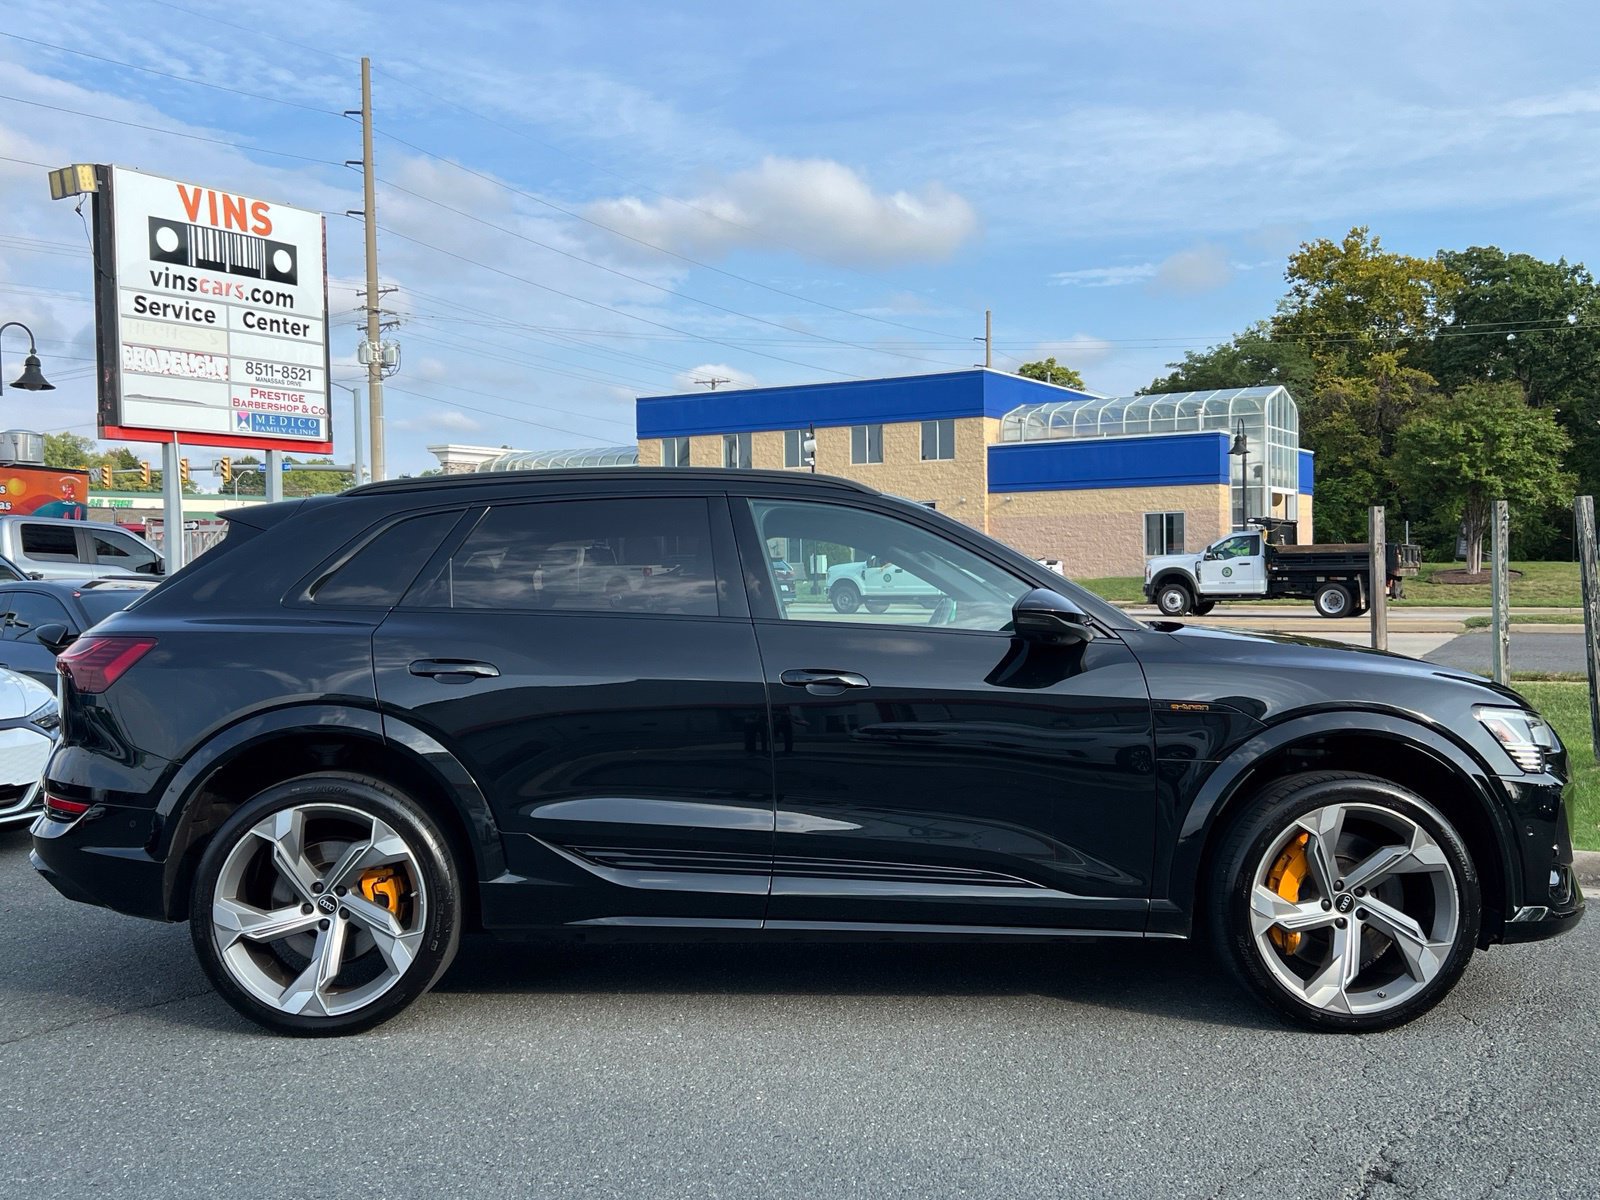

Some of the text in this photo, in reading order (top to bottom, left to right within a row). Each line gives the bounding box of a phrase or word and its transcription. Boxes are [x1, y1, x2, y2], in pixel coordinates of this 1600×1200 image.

[176, 184, 273, 237] VINS
[149, 267, 294, 309] vinscars.com
[133, 295, 216, 324] Service
[242, 311, 310, 337] Center
[245, 361, 312, 381] 8511-8521
[255, 376, 285, 385] MANASSAS
[250, 388, 306, 403] PRESTIGE
[232, 397, 299, 412] BARBERSHOP
[301, 405, 309, 413] &
[255, 414, 317, 428] MEDICO
[255, 425, 287, 433] FAMILY
[288, 428, 318, 436] CLINIC
